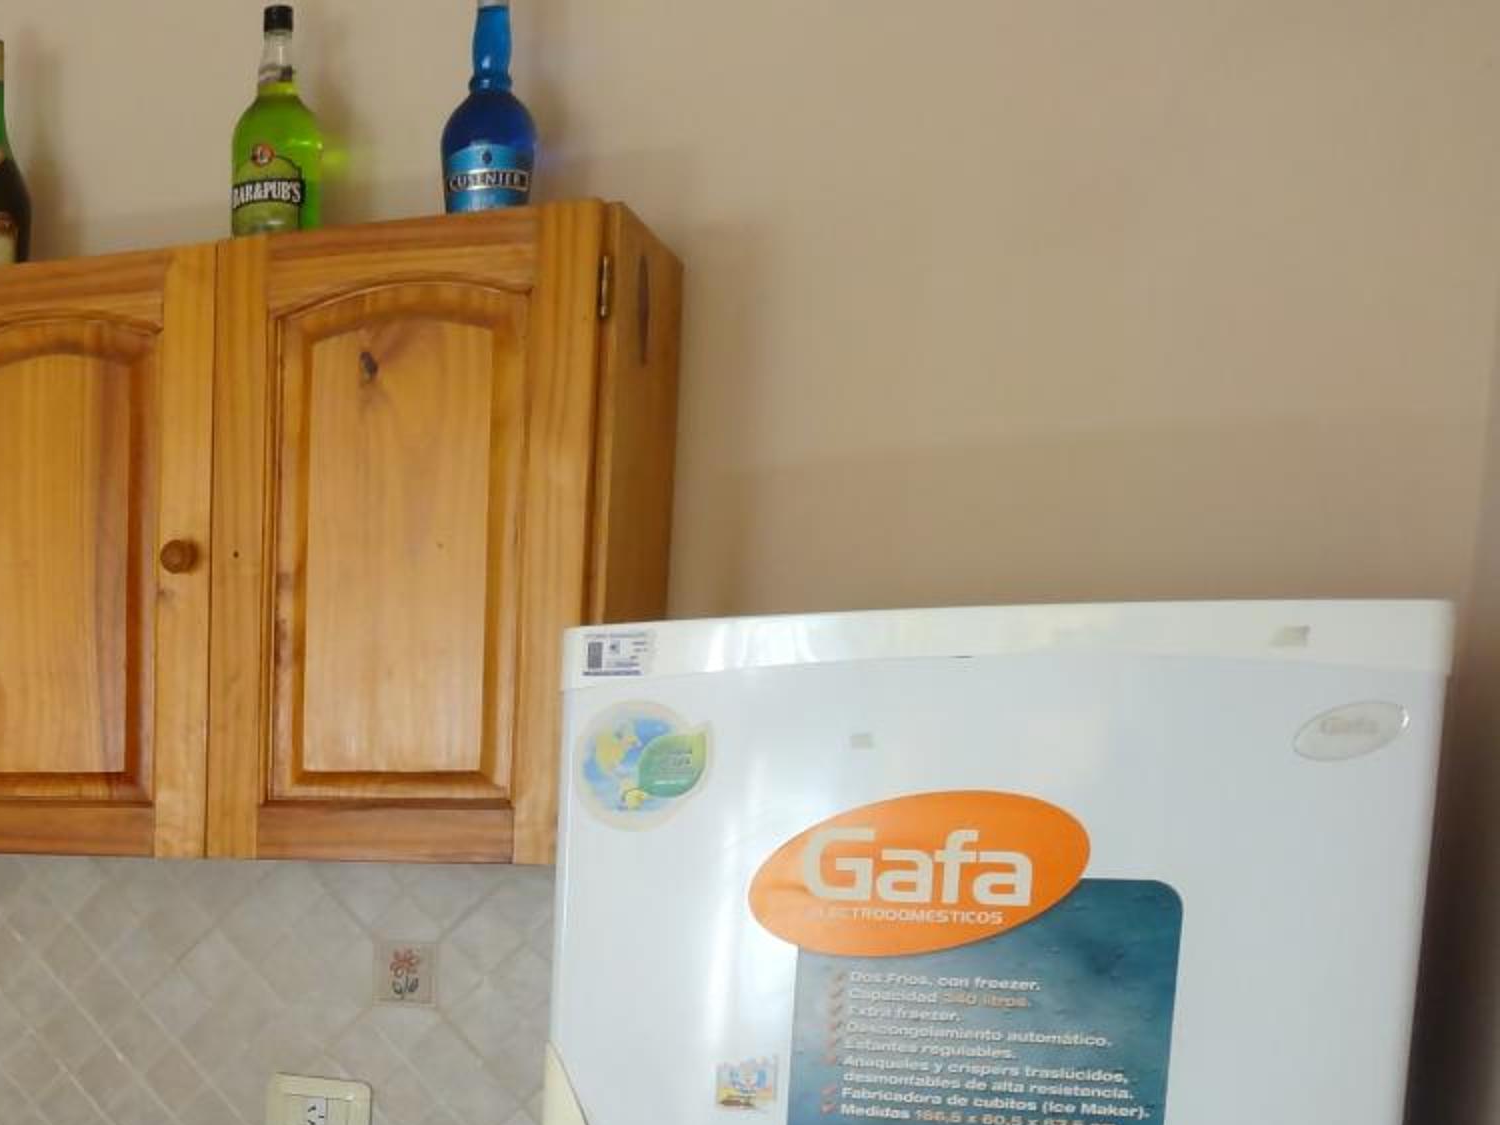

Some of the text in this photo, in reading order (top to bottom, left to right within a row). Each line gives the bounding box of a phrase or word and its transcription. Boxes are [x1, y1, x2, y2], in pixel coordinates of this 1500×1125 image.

[804, 827, 1033, 906] Gafa
[934, 1060, 945, 1074] y
[965, 1077, 987, 1091] de
[992, 1080, 1025, 1094] alta
[841, 1086, 942, 1105] Fabricadora
[947, 1093, 968, 1107] de
[972, 1096, 1038, 1111] cubitos
[840, 1103, 911, 1120] Medidas
